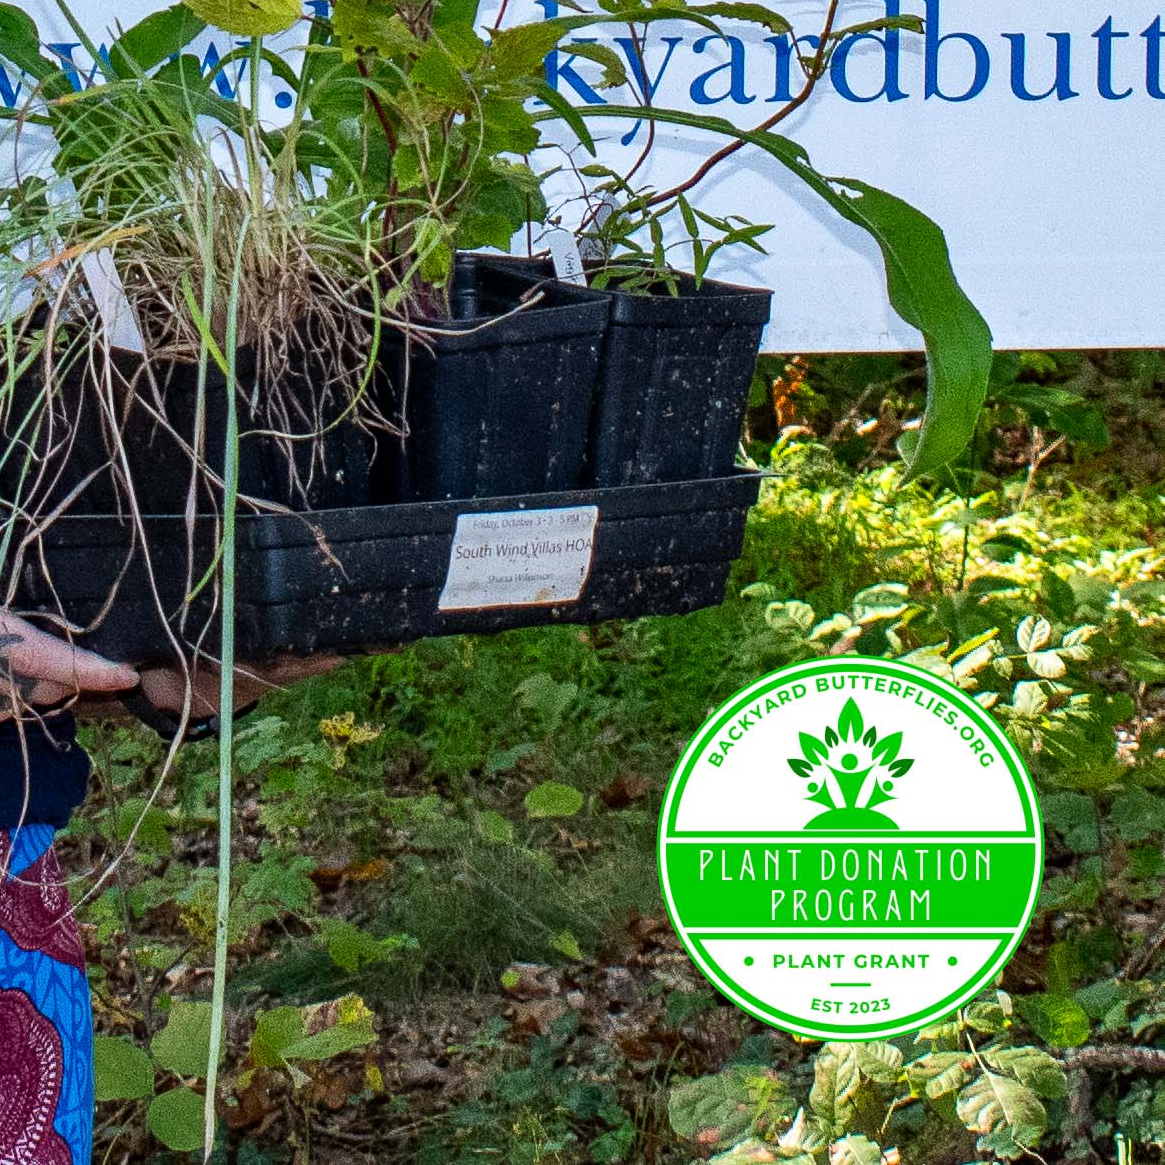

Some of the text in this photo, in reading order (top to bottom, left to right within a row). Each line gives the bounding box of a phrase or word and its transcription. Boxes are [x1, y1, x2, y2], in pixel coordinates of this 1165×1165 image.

[456, 537, 593, 560] South Wind Villas HOA
